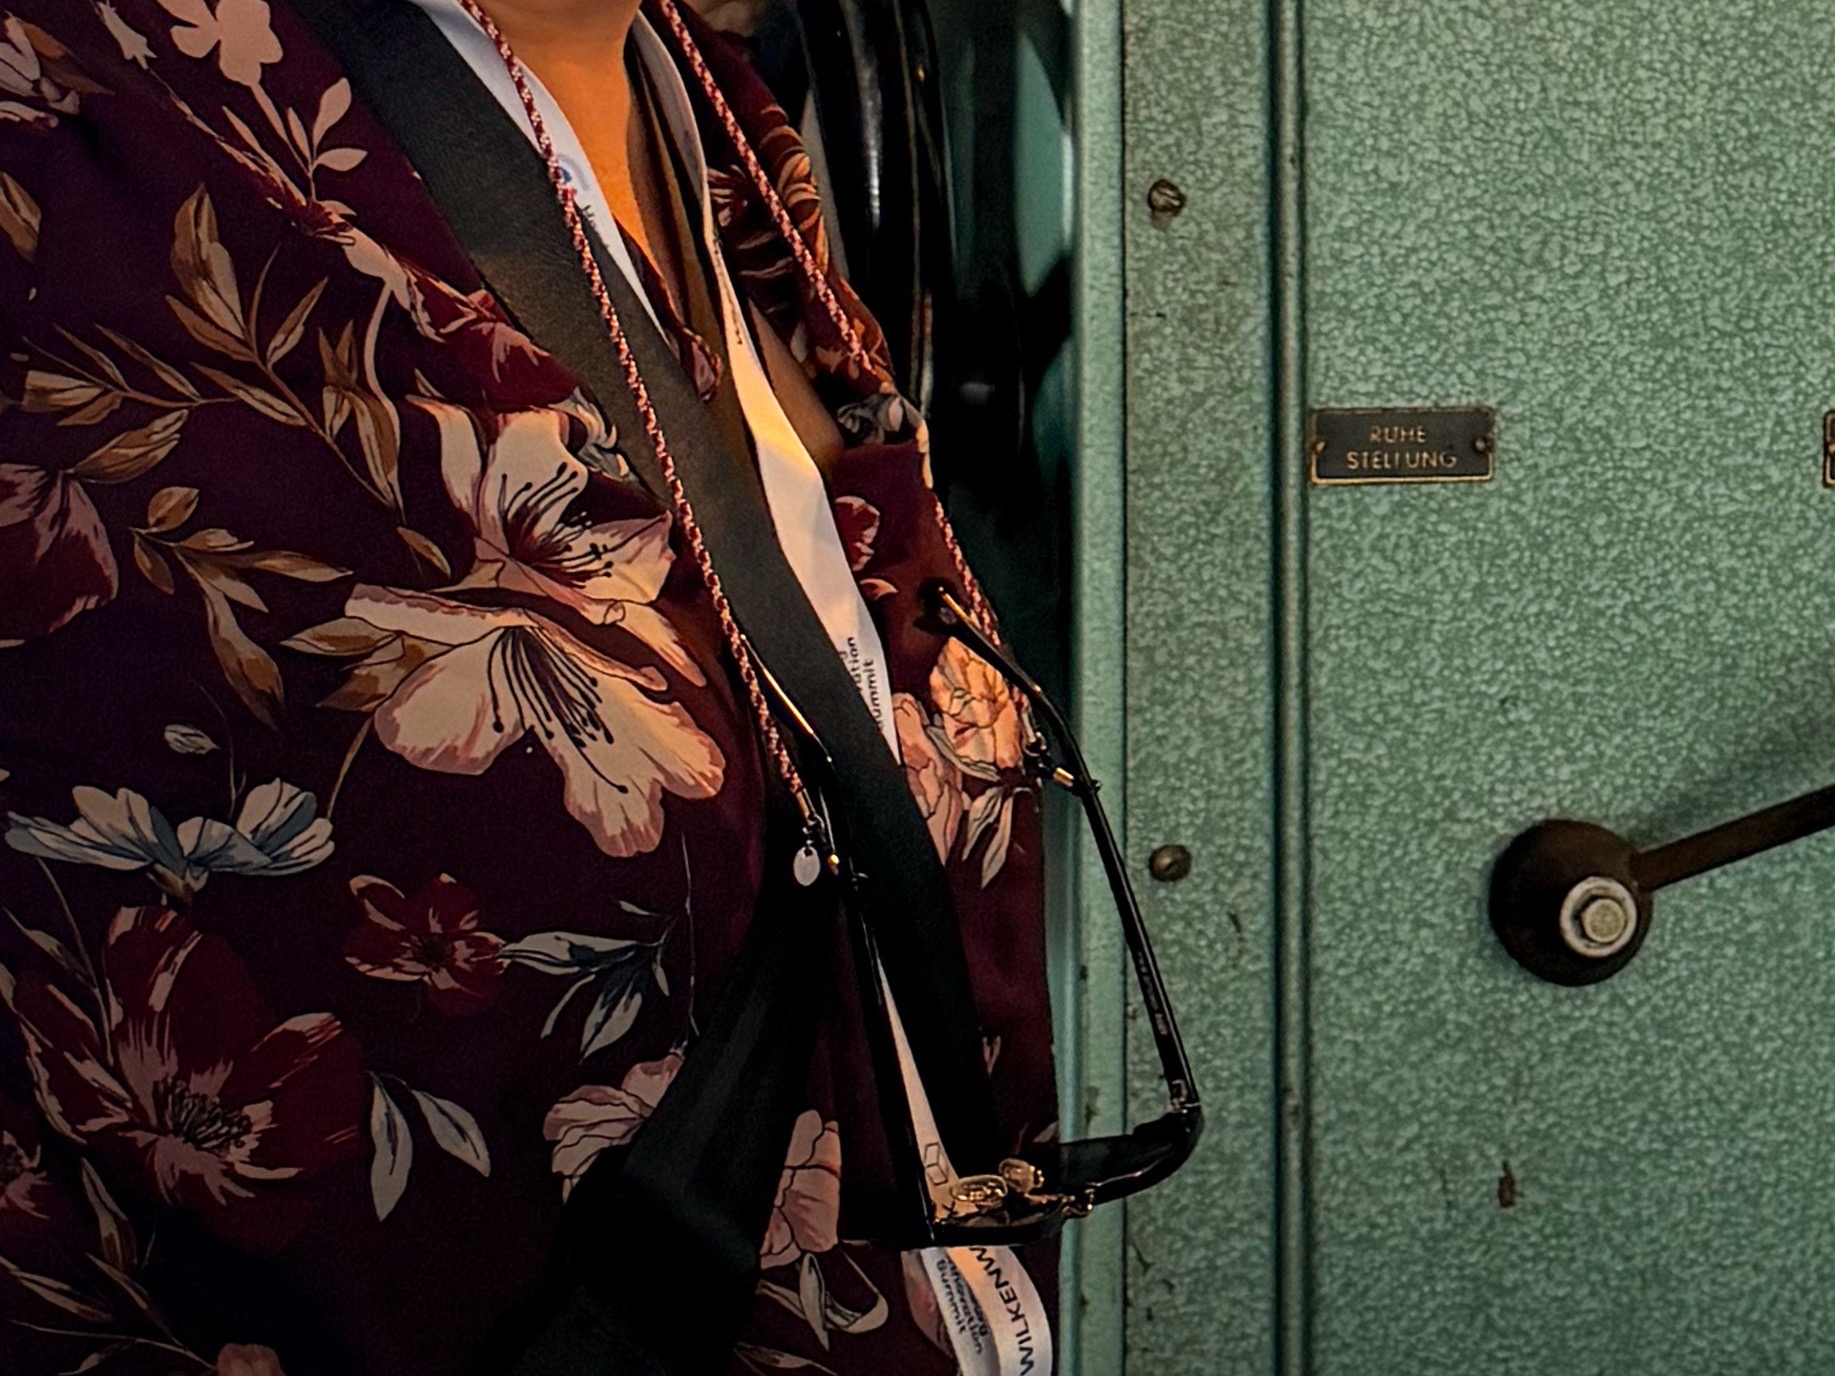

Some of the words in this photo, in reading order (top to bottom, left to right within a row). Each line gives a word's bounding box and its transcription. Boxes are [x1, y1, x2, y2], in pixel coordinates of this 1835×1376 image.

[1369, 426, 1428, 443] RUHE
[1346, 451, 1458, 470] STELLUNG
[969, 1247, 1035, 1376] WILKENW
